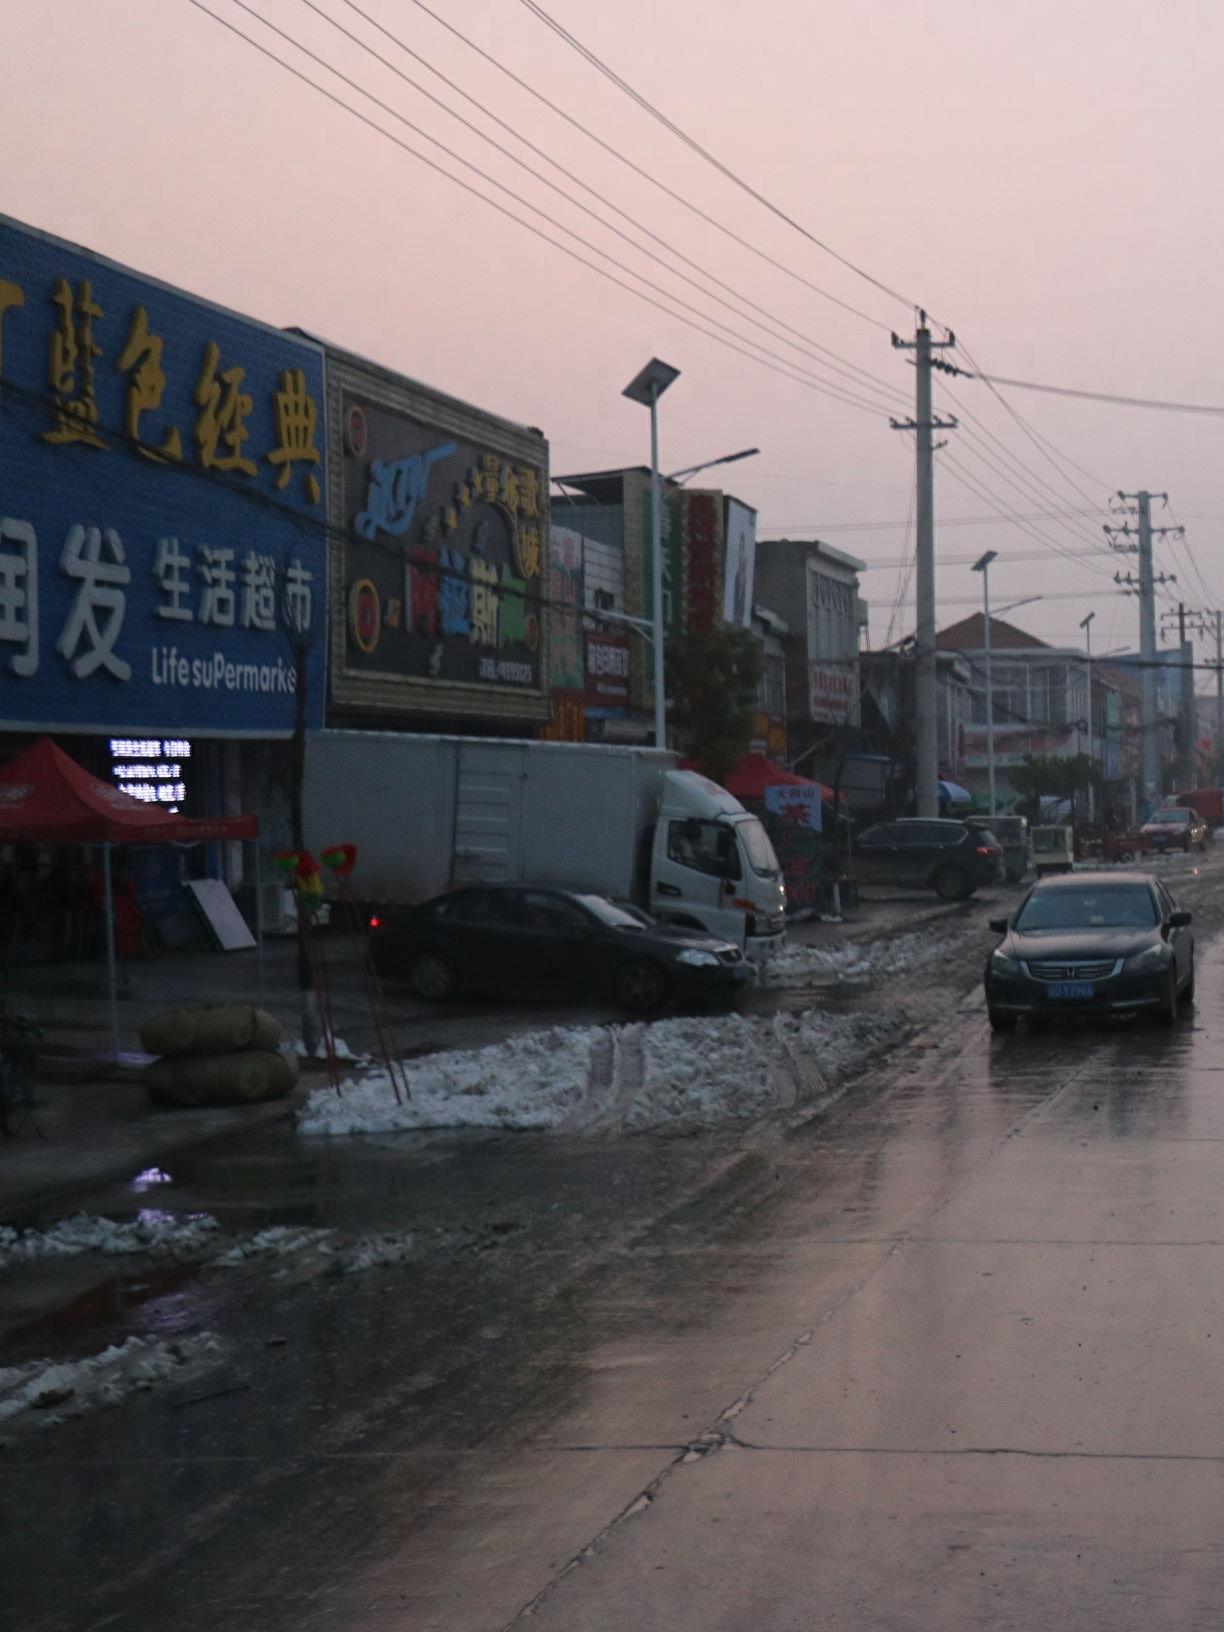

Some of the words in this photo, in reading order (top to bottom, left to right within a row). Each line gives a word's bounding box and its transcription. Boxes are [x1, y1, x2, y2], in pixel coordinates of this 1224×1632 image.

[153, 536, 314, 634] 生活超市
[151, 645, 189, 687] Life
[192, 651, 302, 695] suPermarke
